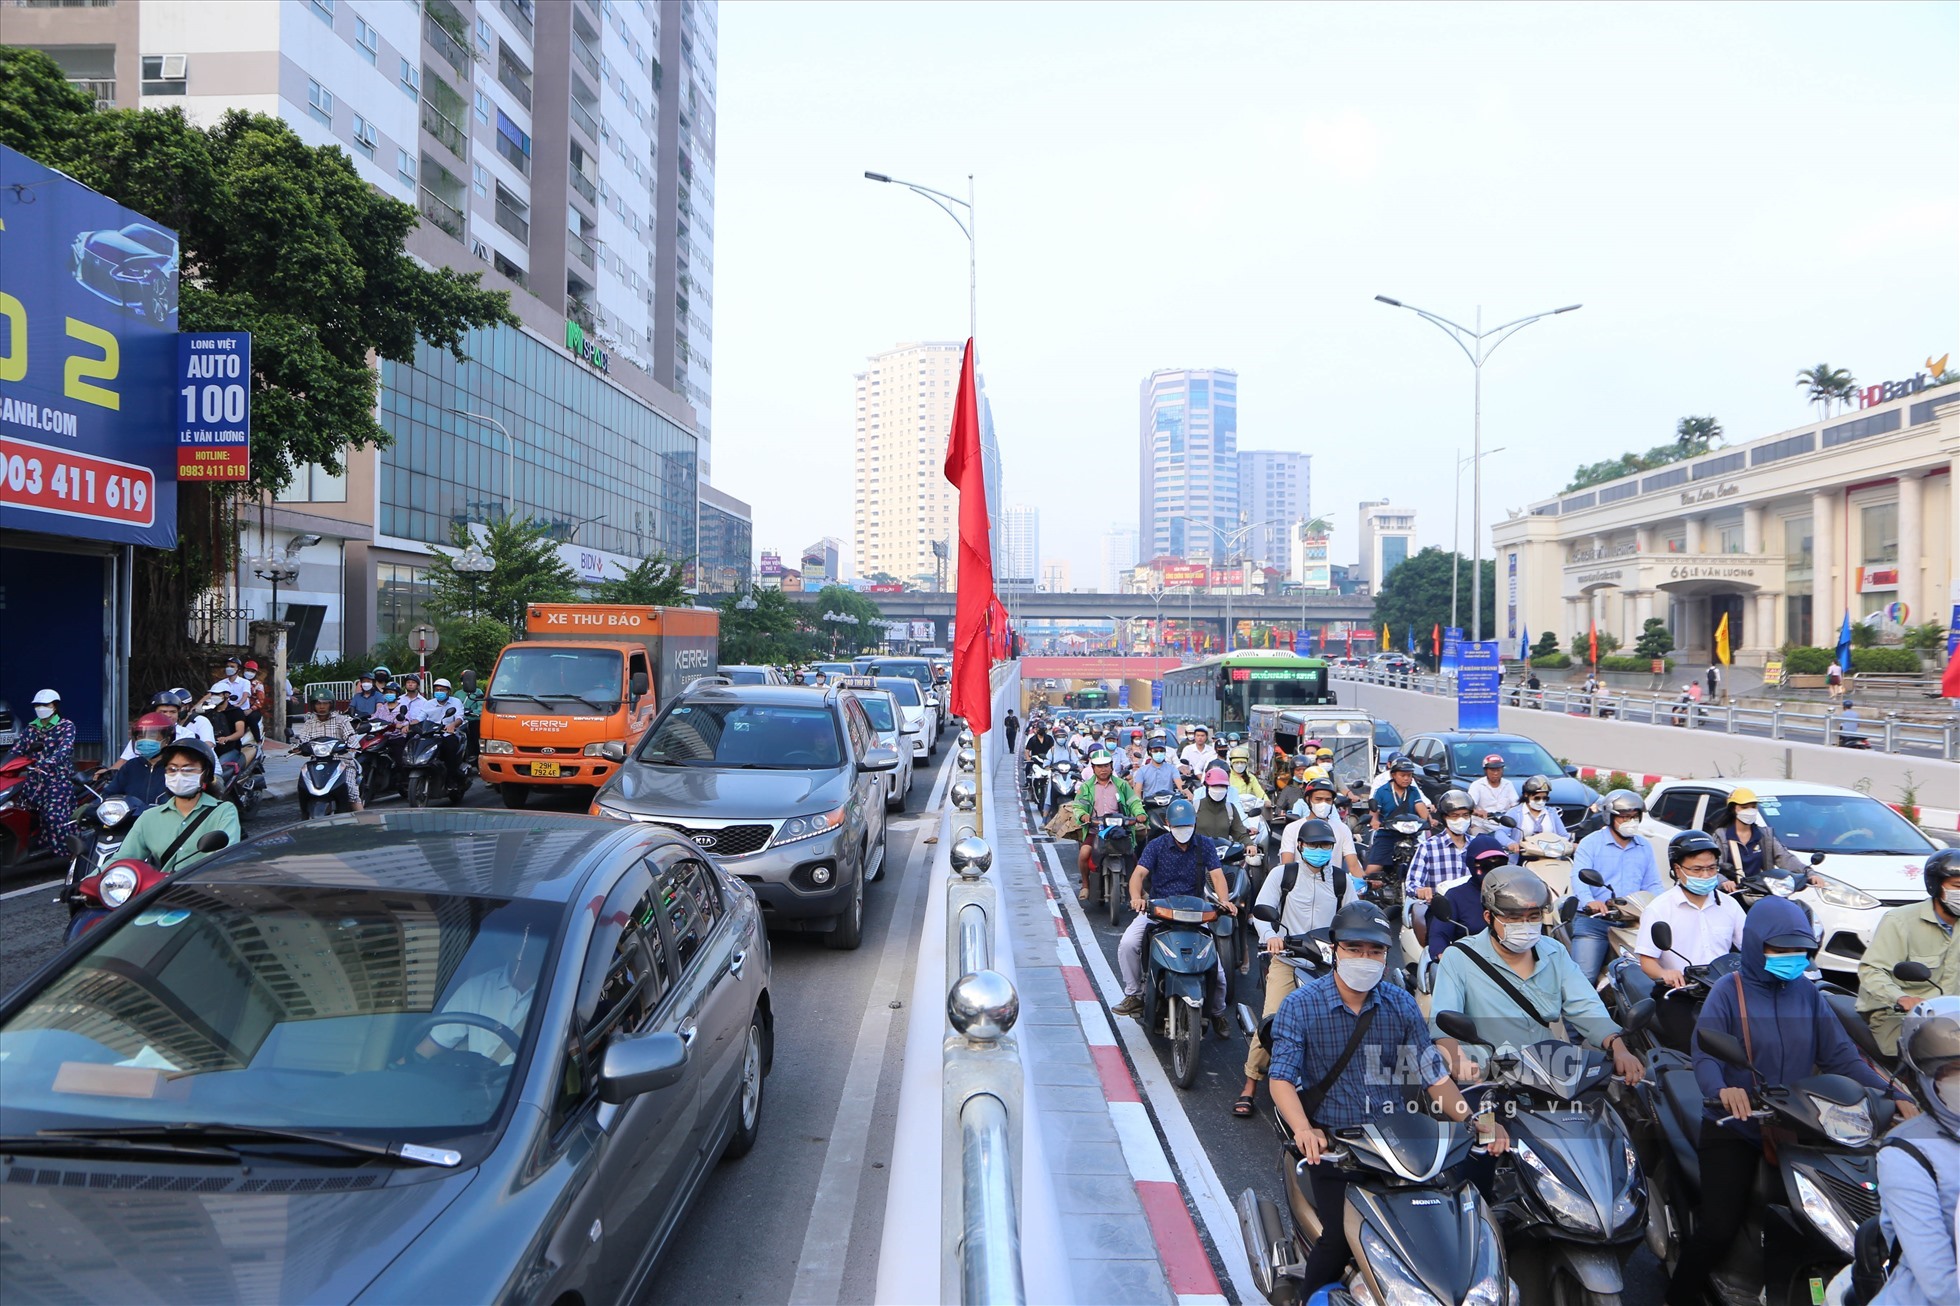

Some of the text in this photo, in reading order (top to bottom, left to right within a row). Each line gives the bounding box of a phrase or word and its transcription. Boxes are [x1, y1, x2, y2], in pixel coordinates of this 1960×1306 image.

[191, 338, 236, 351] LONG VIỆT
[64, 316, 120, 412] 2
[187, 354, 240, 378] AUTO
[1859, 372, 1927, 410] HDBank
[181, 384, 245, 423] 100
[0, 397, 77, 437] ANH.COM
[181, 429, 245, 443] LÊ VĂN LƯƠNG
[195, 451, 230, 461] HOTLINE:
[180, 465, 246, 477] 0983 411 619
[51, 463, 96, 504] 411
[105, 474, 147, 512] 619
[581, 553, 597, 571] BIDV
[1671, 566, 1689, 579] 66
[1690, 567, 1698, 577] LÊ
[1701, 566, 1720, 577] VĂN
[547, 611, 641, 626] XE THƯ BÁO
[674, 649, 709, 670] KERRY
[521, 720, 568, 728] KERRY
